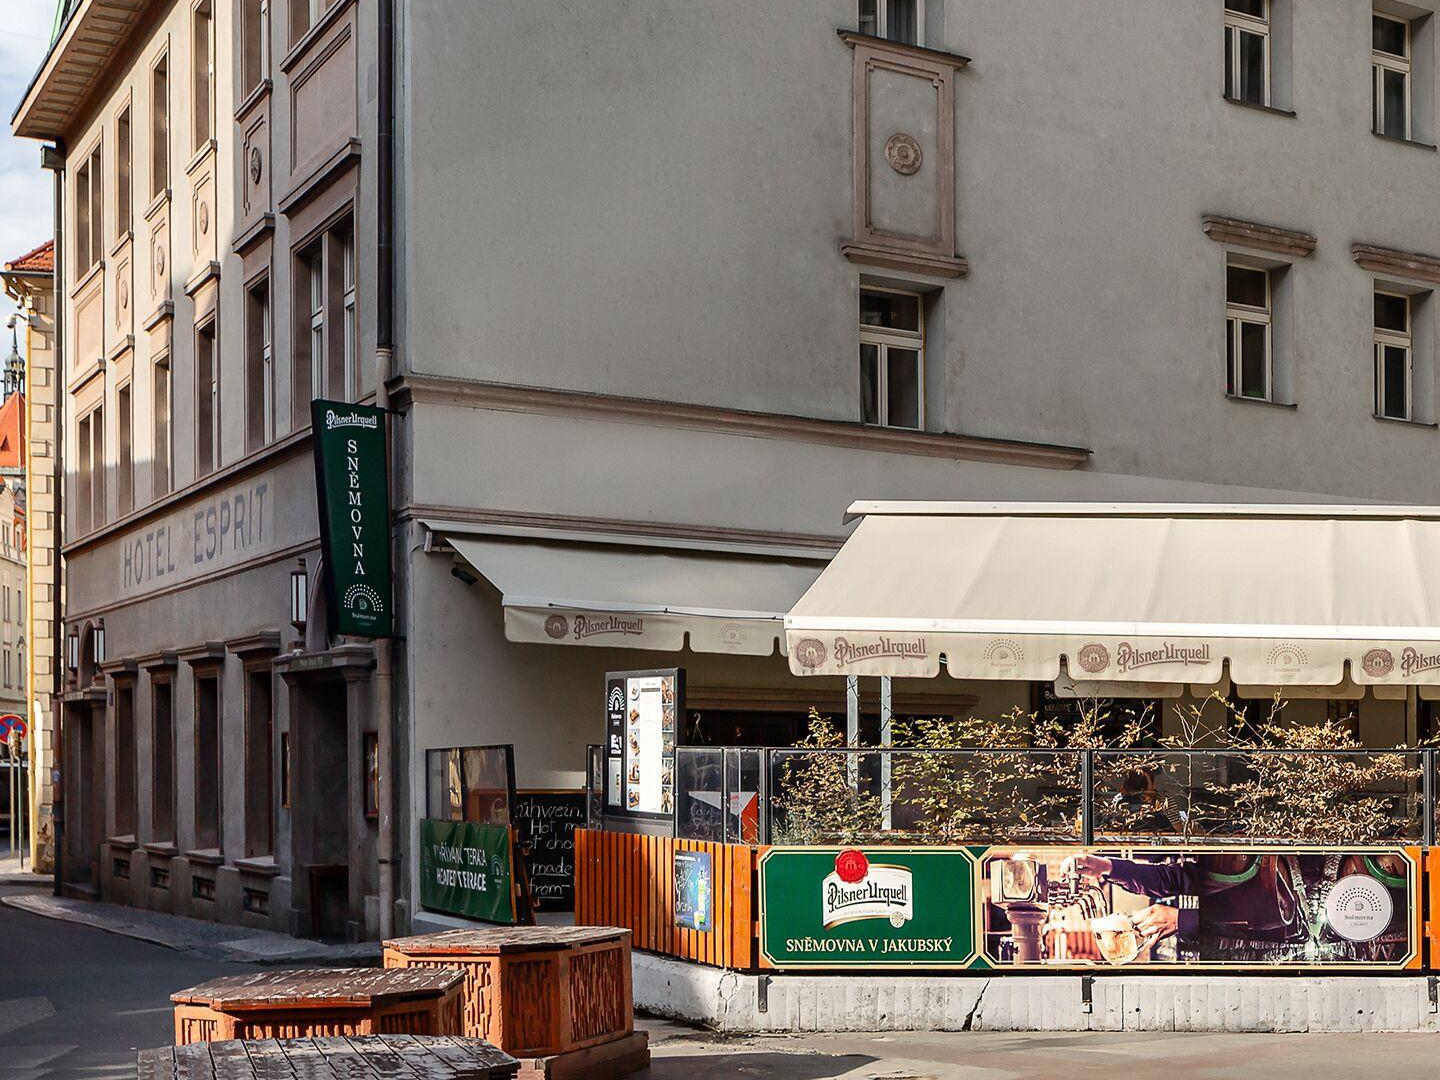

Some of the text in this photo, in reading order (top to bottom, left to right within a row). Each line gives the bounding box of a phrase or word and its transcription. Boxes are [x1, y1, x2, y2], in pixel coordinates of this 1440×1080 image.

[347, 439, 365, 575] SNĚMOVNA
[123, 483, 267, 588] HOTEL ESPRIT
[574, 615, 643, 640] Pilsner Urquell
[834, 636, 927, 668] Pilsner Urquell
[1117, 642, 1210, 673] Pilsner Urquell
[533, 856, 572, 876] made
[827, 881, 908, 913] Pilsner Urquell
[786, 936, 953, 953] SNĚMOVNA V JAKUBSKÝ
